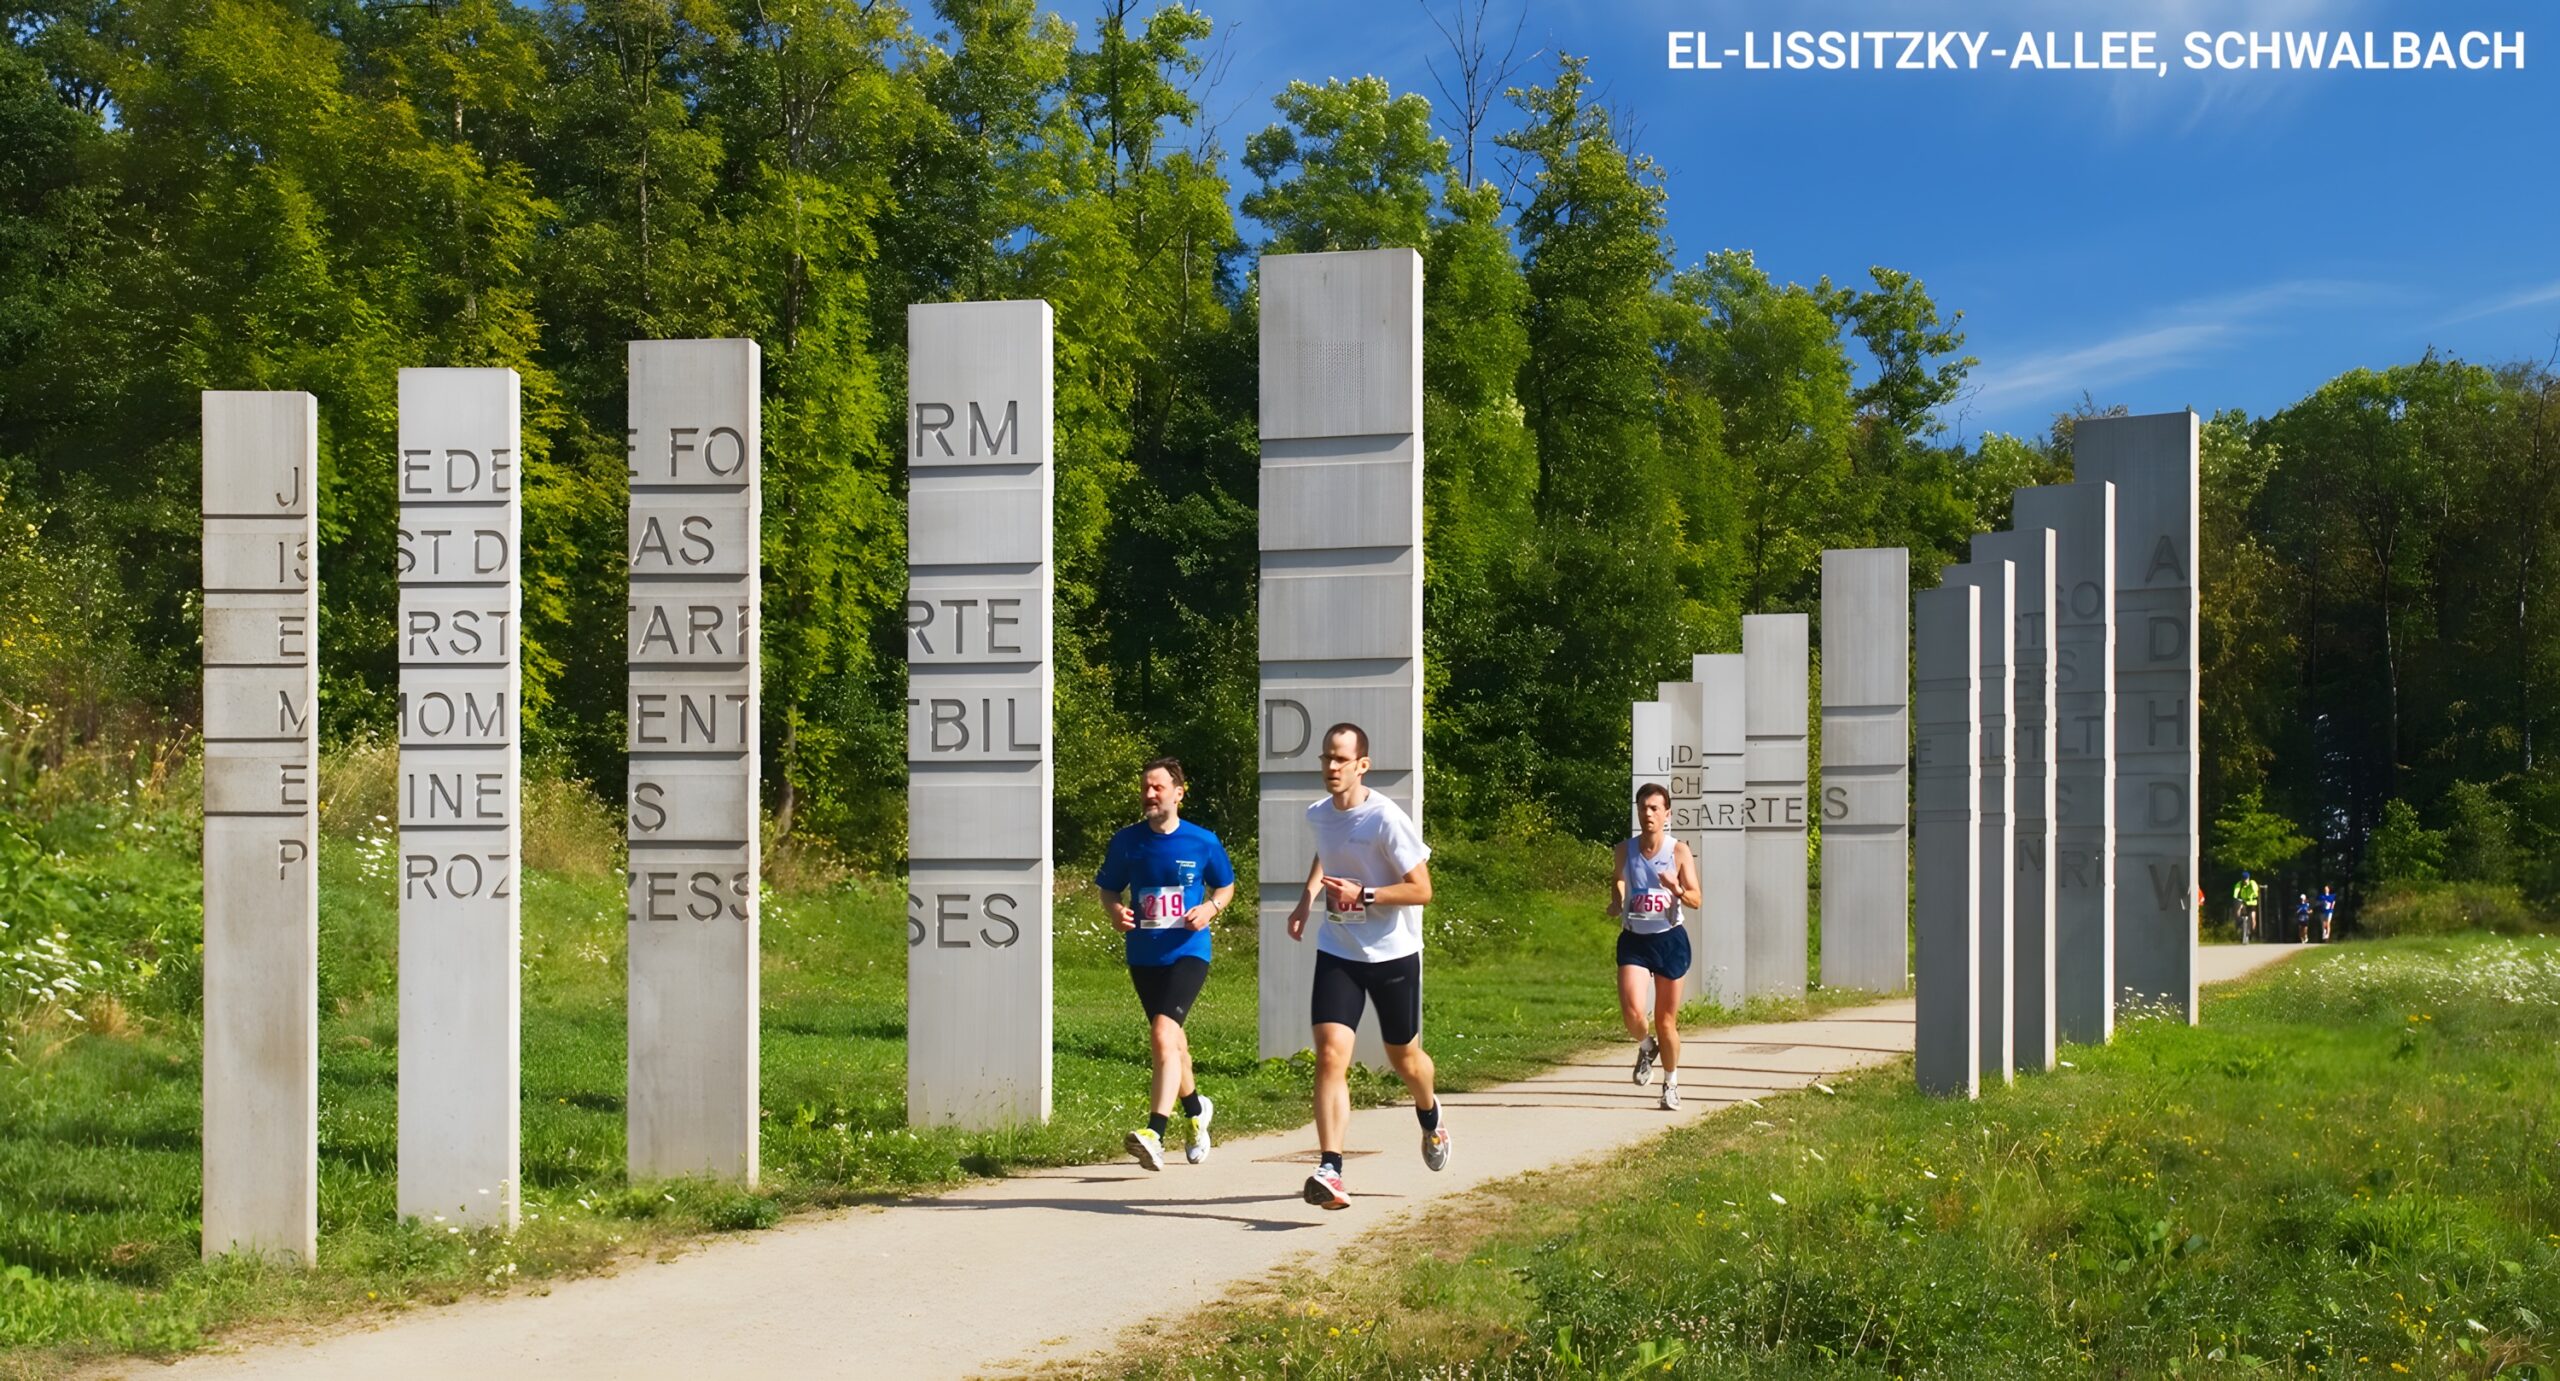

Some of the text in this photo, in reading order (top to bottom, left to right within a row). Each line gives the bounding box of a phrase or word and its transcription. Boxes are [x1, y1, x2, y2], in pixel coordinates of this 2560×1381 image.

[669, 426, 745, 477] FO
[914, 400, 1018, 457] RM
[276, 467, 299, 507] J
[474, 530, 508, 574] D
[631, 516, 714, 566] AS
[2145, 535, 2185, 583] A
[279, 616, 305, 657] E
[2149, 616, 2186, 662] D
[1265, 699, 1311, 760] D
[2149, 700, 2184, 746] H
[280, 764, 307, 805] E
[409, 773, 504, 819] INE
[631, 782, 666, 833] S
[1823, 786, 1849, 820] S
[2148, 782, 2185, 829] D
[279, 839, 308, 880] P
[1144, 893, 1183, 919] 219
